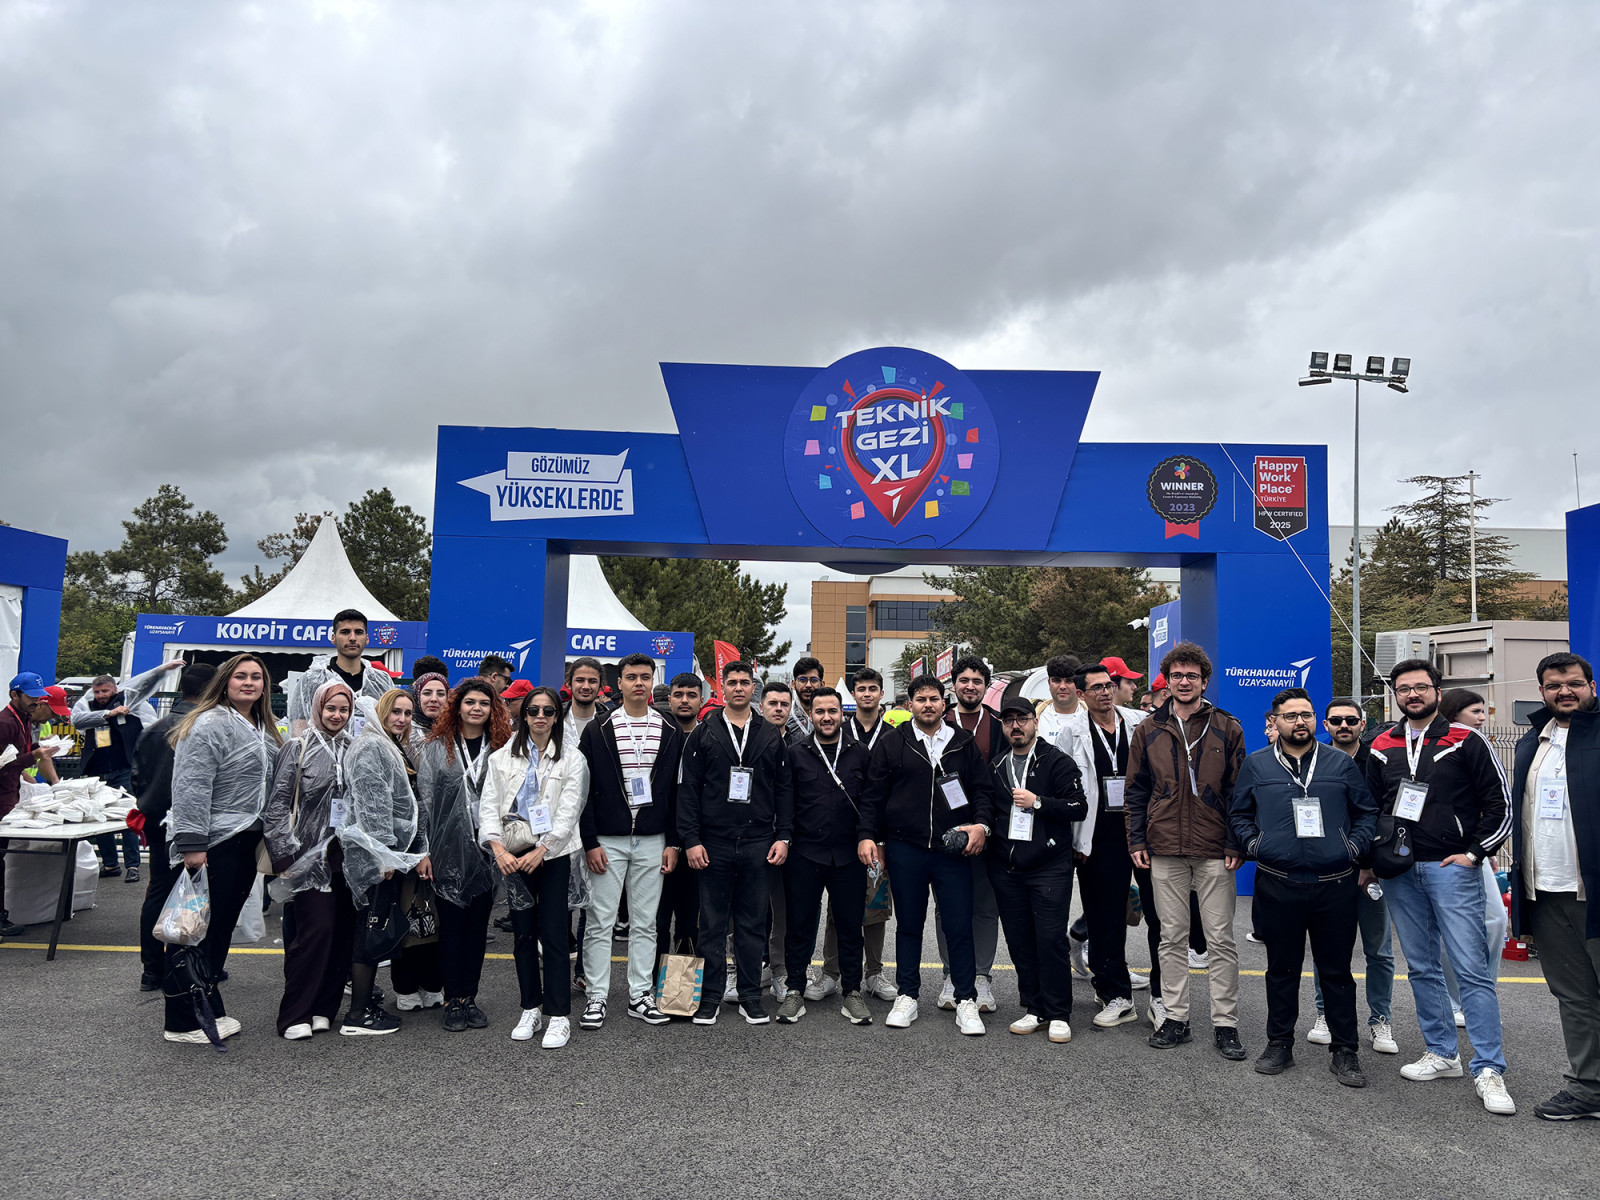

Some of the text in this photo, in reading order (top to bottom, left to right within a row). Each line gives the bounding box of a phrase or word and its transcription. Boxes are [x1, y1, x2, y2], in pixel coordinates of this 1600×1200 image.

[835, 394, 951, 429] TEKNİK
[856, 420, 929, 451] GEZİ
[531, 455, 590, 475] GÖZÜMÜZ
[870, 453, 922, 485] XL
[1259, 460, 1298, 472] Happy
[1259, 472, 1291, 482] Work
[1160, 482, 1204, 491] WINNER
[496, 482, 624, 511] YÜKSEKLERDE
[1169, 503, 1196, 512] 2023
[1269, 521, 1291, 529] 2025
[216, 621, 288, 640] KOKPİT
[571, 634, 617, 651] CAFE
[1225, 666, 1297, 678] TÜRKHAVACILIK
[1238, 678, 1295, 687] UZAYSANAYİİ
